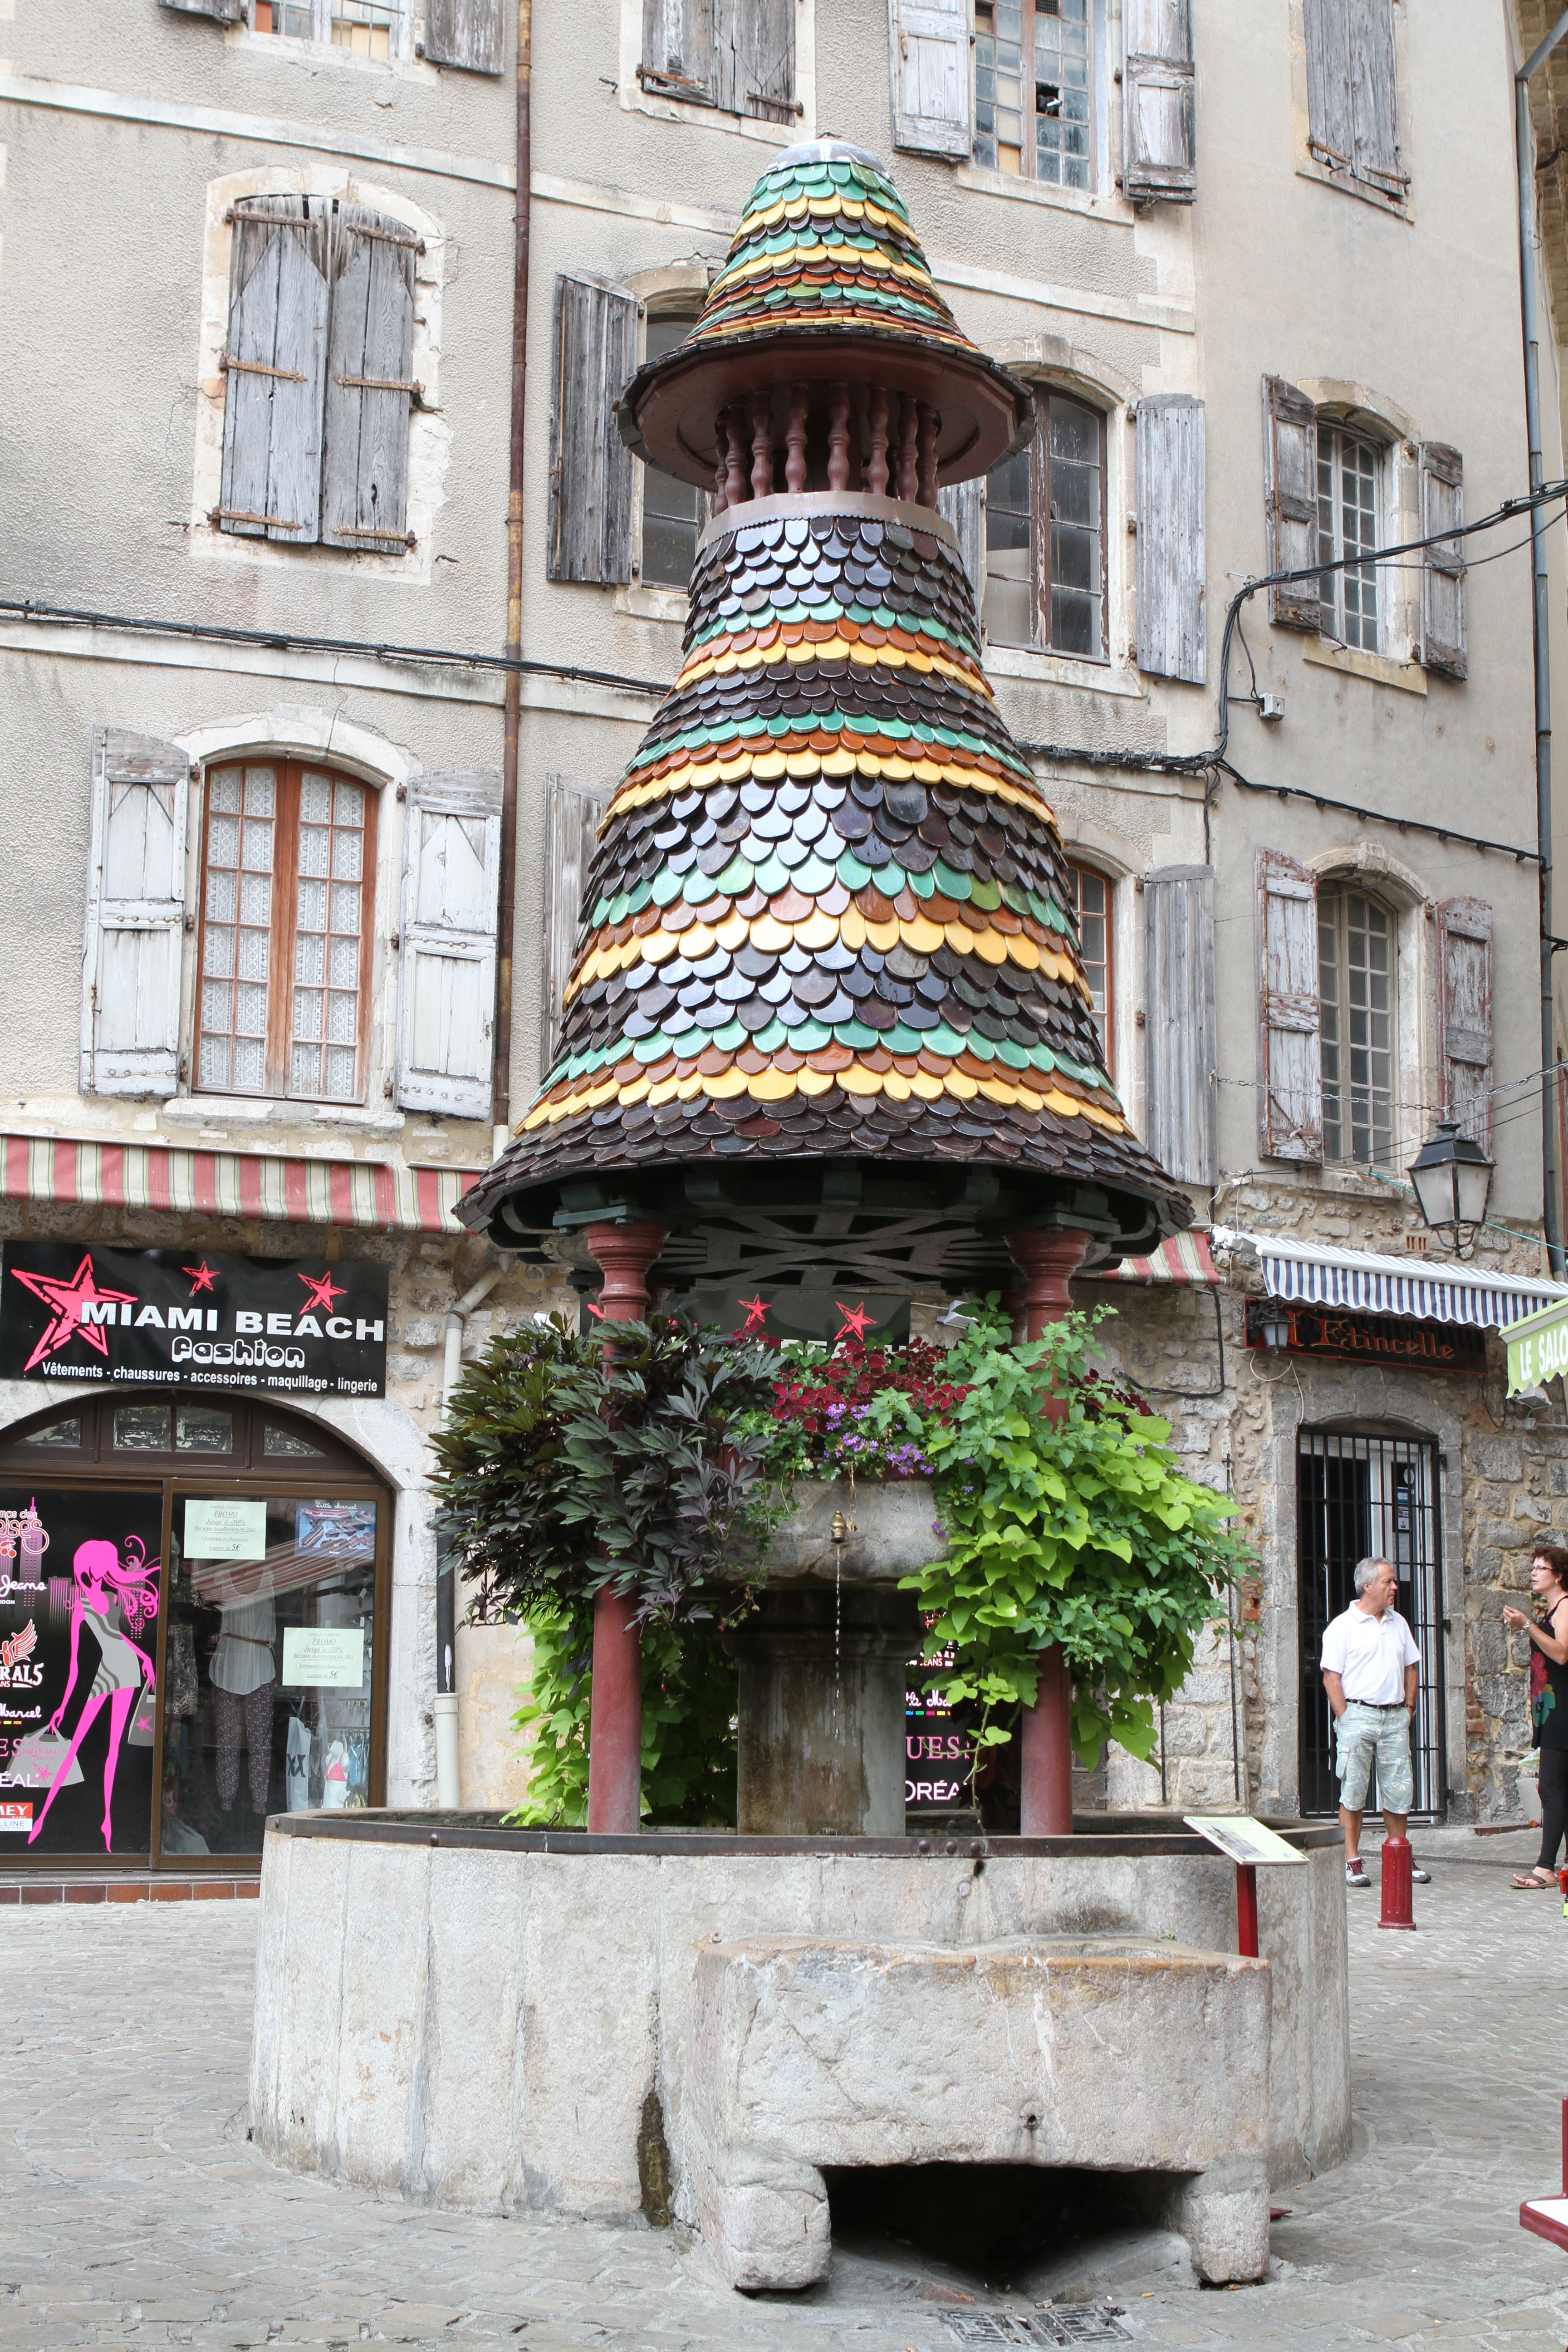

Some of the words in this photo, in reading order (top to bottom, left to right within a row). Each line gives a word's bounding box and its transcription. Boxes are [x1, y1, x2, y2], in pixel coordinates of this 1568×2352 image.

[80, 1301, 218, 1331] MIAMI
[235, 1311, 384, 1342] BEACH
[1520, 1340, 1532, 1382] LE
[42, 1362, 103, 1377] Vêtements
[113, 1366, 180, 1381] chaussures
[190, 1372, 257, 1386] accessoires
[268, 1375, 328, 1391] maquillage
[338, 1377, 377, 1393] lingerie
[19, 1509, 38, 1519] des
[315, 1500, 332, 1509] Little
[0, 1574, 47, 1597] Jeans
